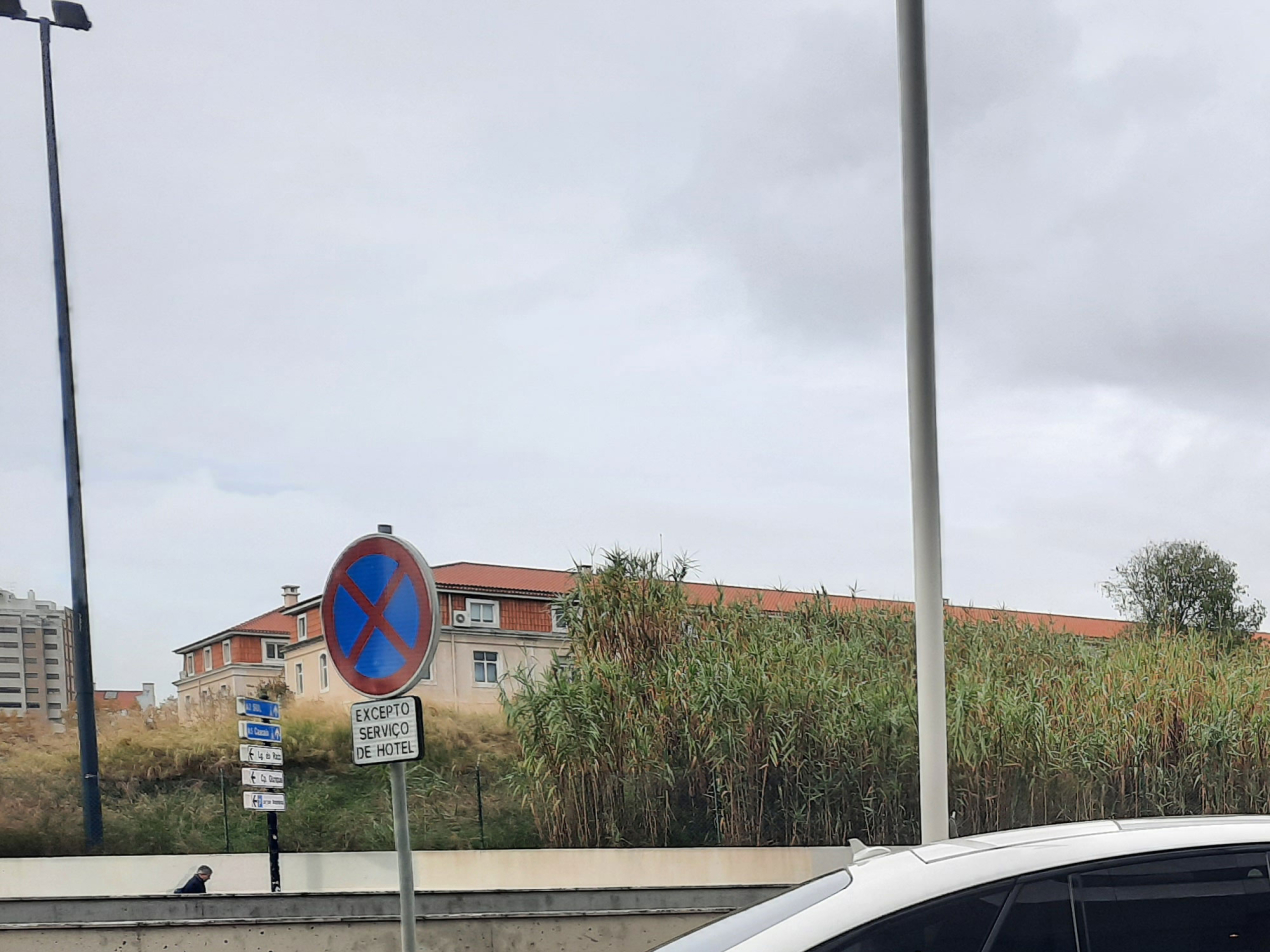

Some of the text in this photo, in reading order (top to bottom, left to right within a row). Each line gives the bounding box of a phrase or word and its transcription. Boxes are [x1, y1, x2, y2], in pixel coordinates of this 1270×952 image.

[355, 702, 410, 722] EXCEPTO
[359, 722, 409, 741] SERVIÇO
[356, 741, 414, 760] DE HOTEL
